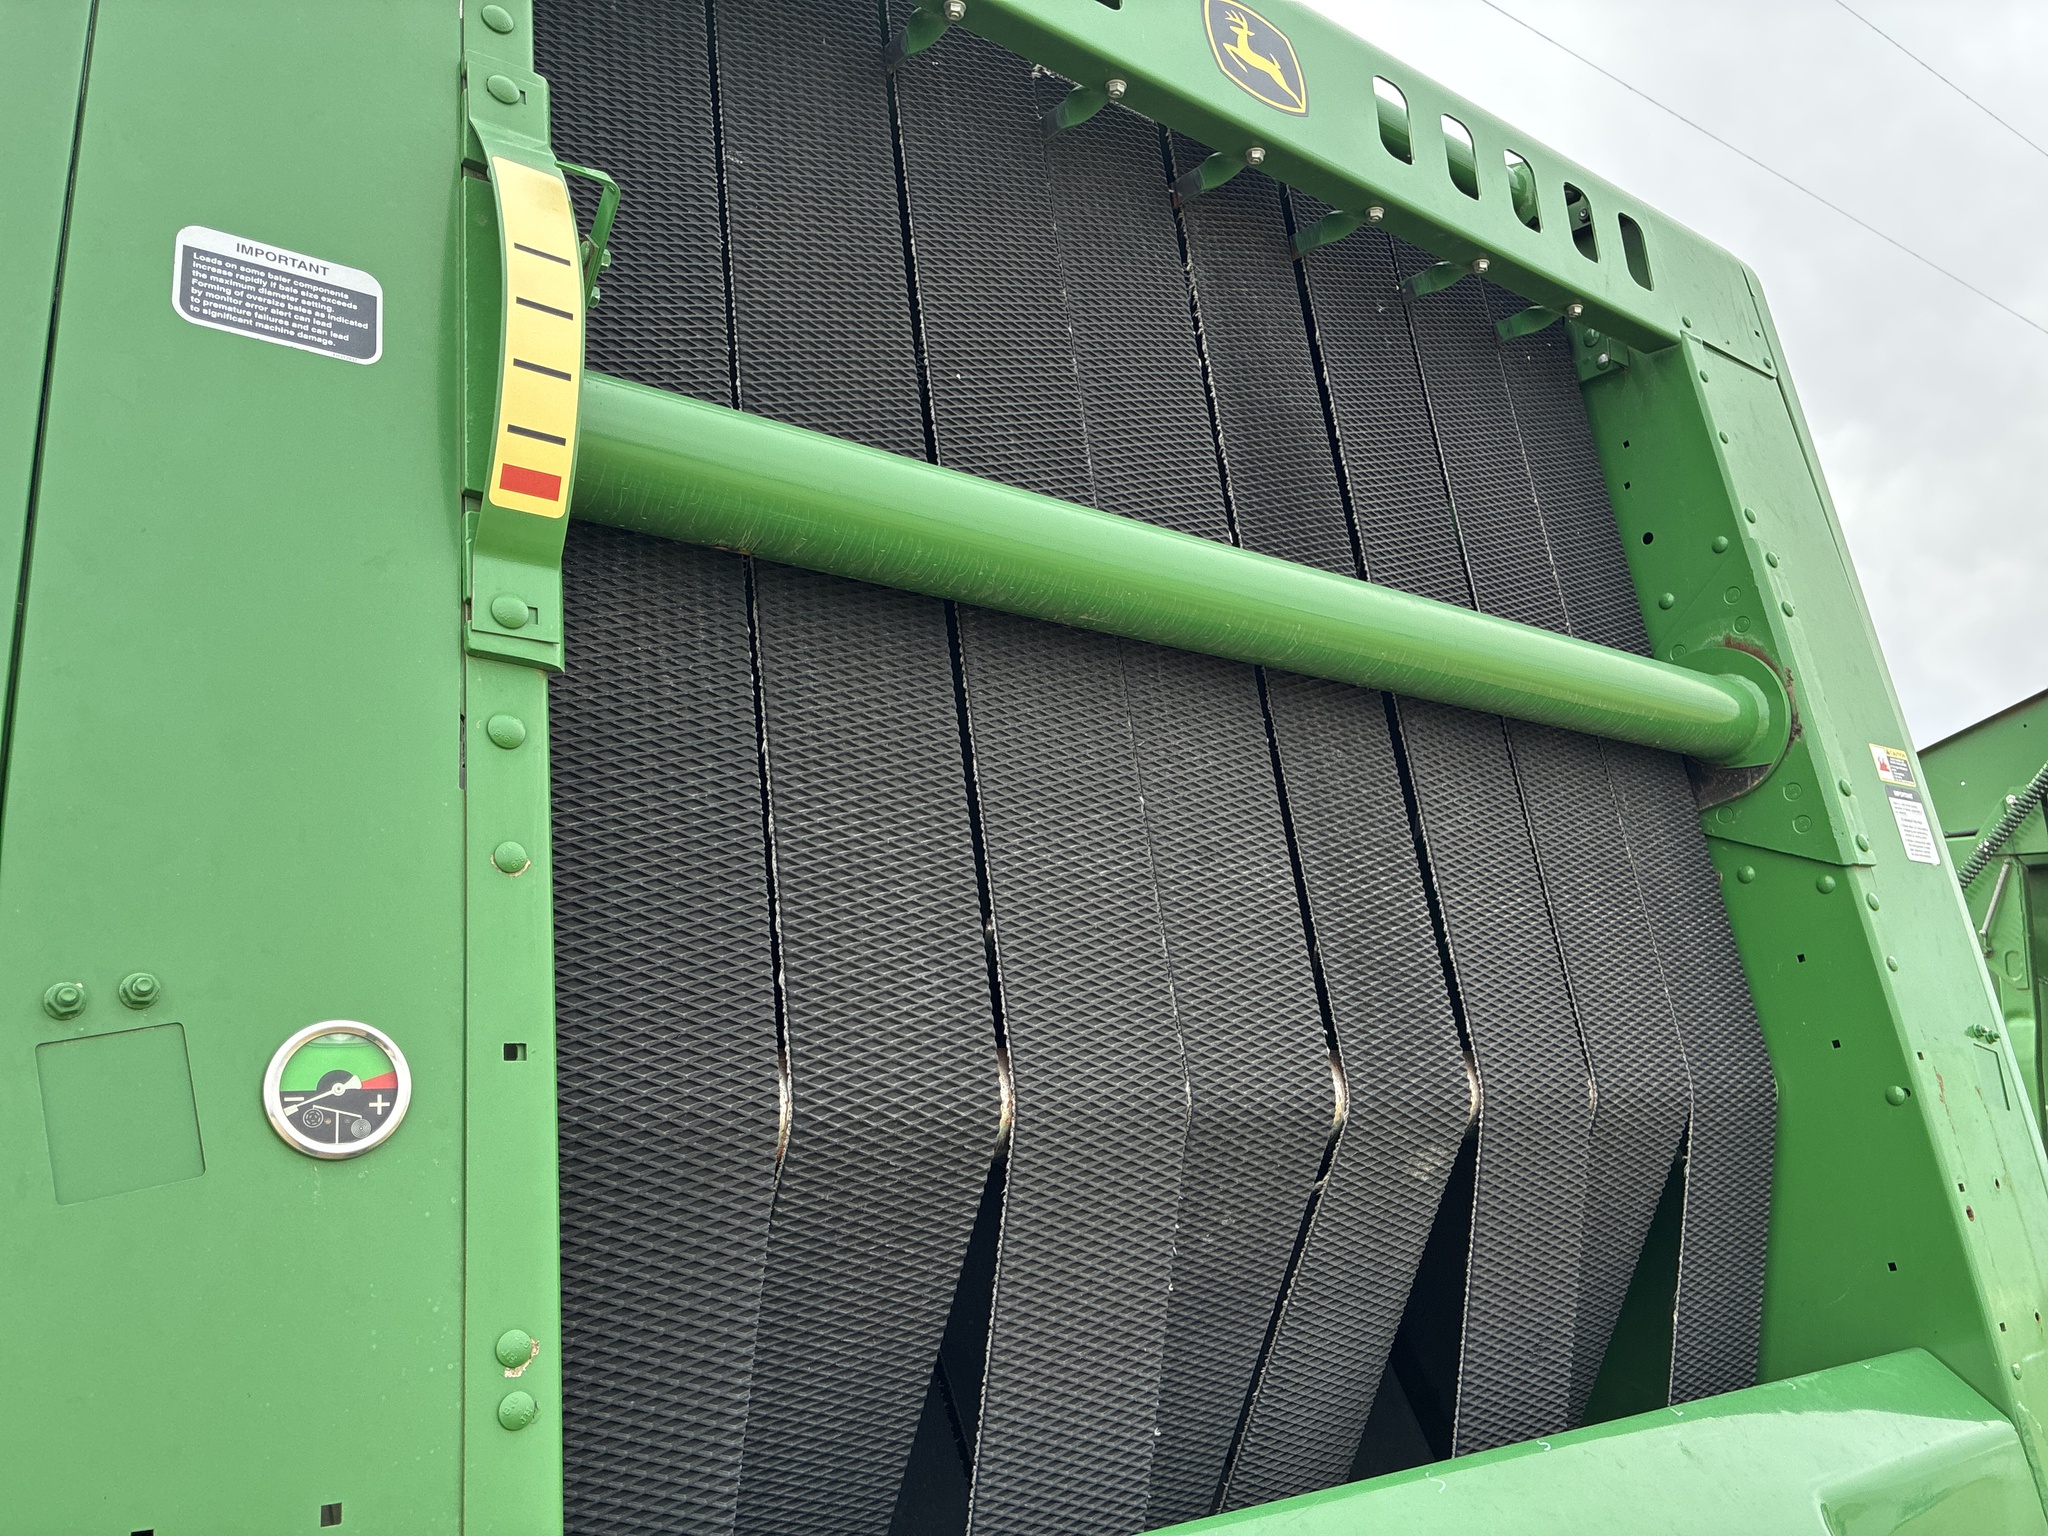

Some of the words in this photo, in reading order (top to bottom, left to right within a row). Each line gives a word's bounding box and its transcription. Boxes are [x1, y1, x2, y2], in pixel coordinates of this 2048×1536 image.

[193, 252, 222, 266] Loads
[225, 262, 237, 270] on
[240, 265, 265, 276] some
[268, 271, 291, 284] baler
[294, 280, 348, 299] components
[236, 243, 329, 276] IMPORTANT
[192, 270, 206, 280] the
[209, 275, 256, 292] maximum
[258, 287, 298, 302] diameter
[301, 297, 334, 312] setting.
[192, 279, 232, 295] Forming
[246, 293, 285, 307] oversize
[288, 302, 312, 316] bales
[328, 313, 368, 329] indicated
[193, 262, 233, 276] increase
[236, 274, 267, 287] rapidly
[270, 281, 276, 290] if
[279, 284, 298, 294] bale
[301, 289, 319, 299] size
[321, 295, 357, 310] exceeds
[191, 287, 202, 298] by
[206, 292, 242, 305] monitor
[245, 302, 268, 312] error
[271, 306, 291, 318] alert
[294, 314, 310, 323] can
[313, 317, 332, 328] lead
[203, 301, 252, 317] premature
[254, 311, 289, 326] failures
[292, 320, 308, 330] and
[311, 328, 327, 336] can
[330, 330, 349, 341] lead
[203, 308, 253, 327] significant
[256, 322, 295, 336] machine
[297, 332, 336, 346] damage.
